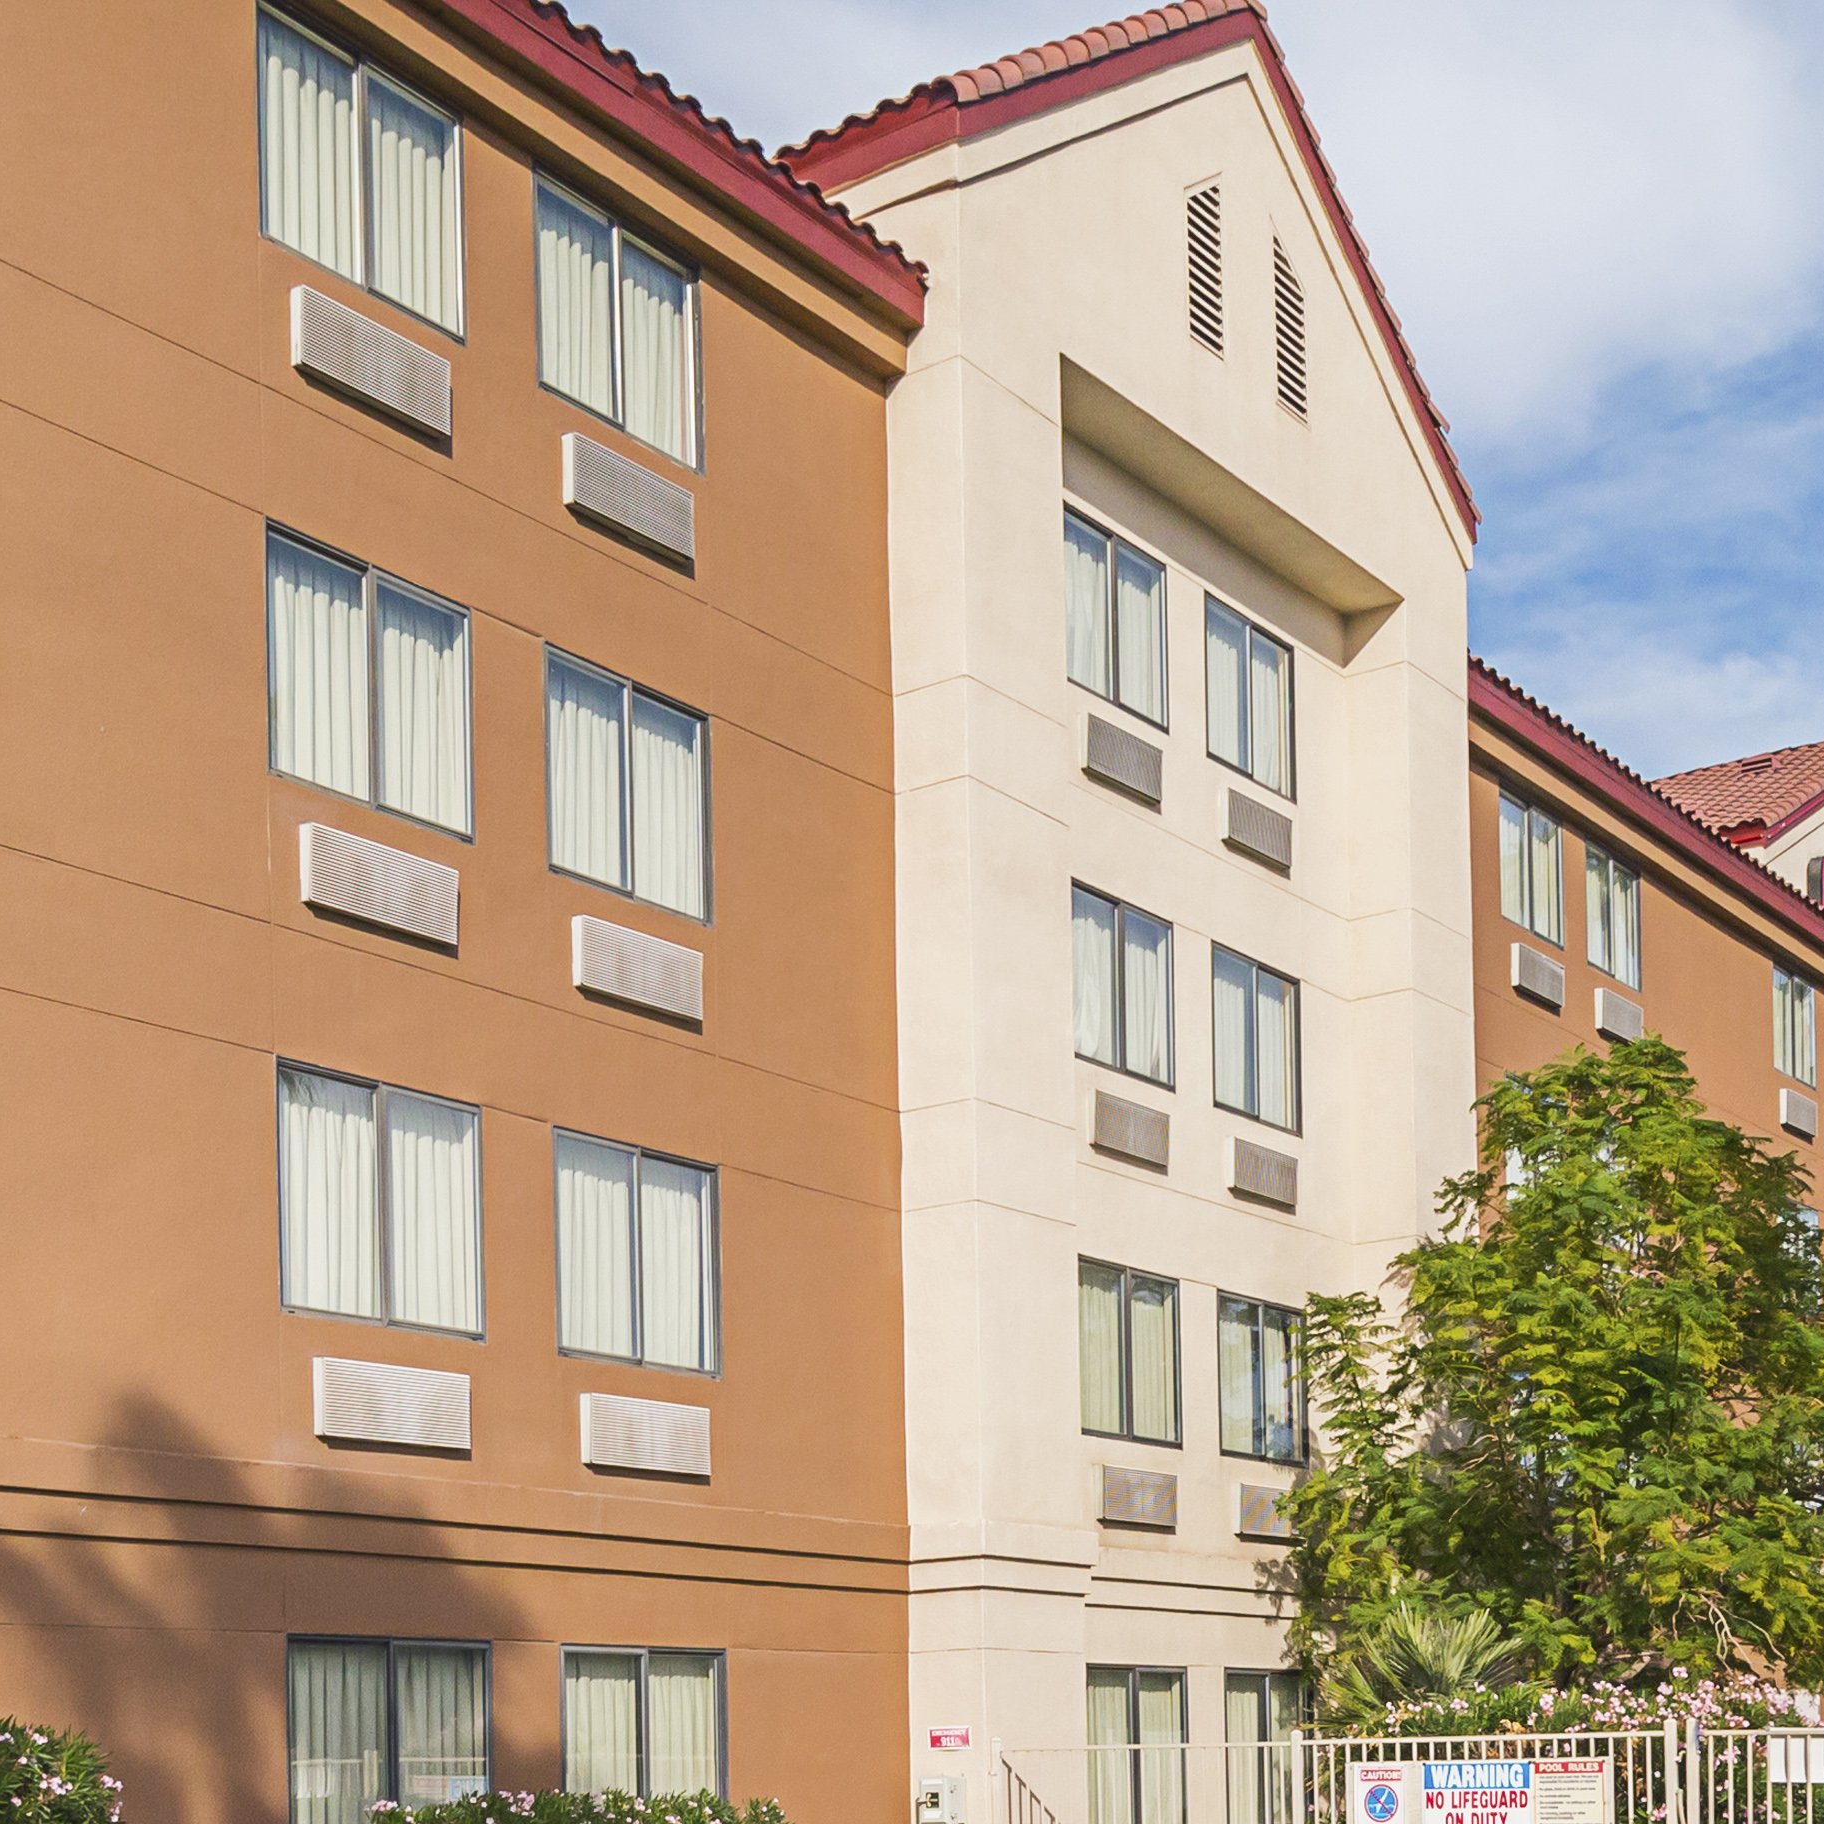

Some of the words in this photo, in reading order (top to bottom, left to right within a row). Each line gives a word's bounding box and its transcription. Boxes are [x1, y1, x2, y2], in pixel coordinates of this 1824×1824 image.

[940, 1736, 955, 1746] 911
[1539, 1763, 1564, 1772] POOL
[1568, 1762, 1600, 1772] RULES
[1430, 1763, 1524, 1788] WARNING
[1425, 1791, 1444, 1809] NO
[1451, 1790, 1528, 1809] LIFEGUARD
